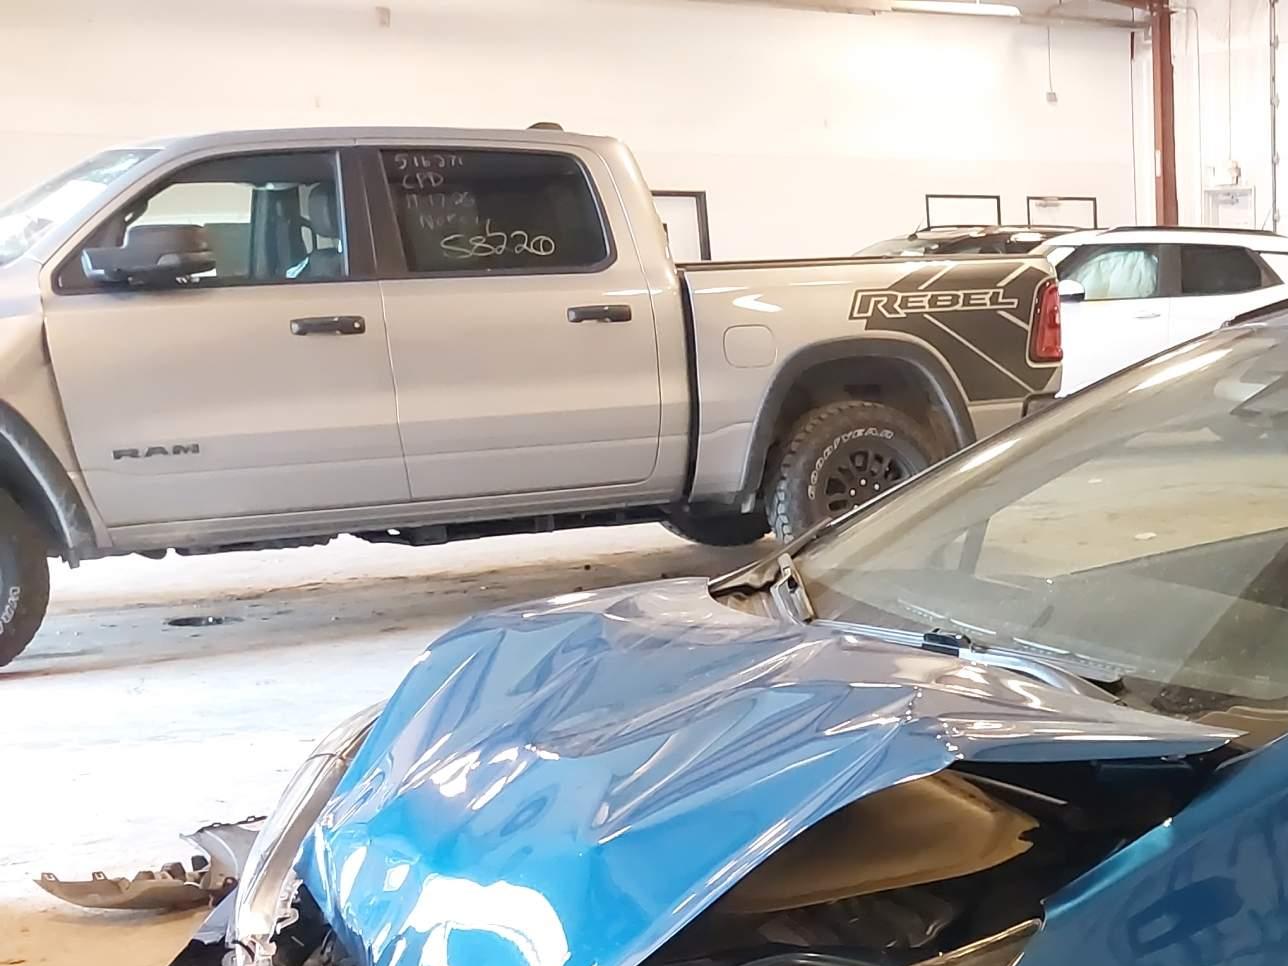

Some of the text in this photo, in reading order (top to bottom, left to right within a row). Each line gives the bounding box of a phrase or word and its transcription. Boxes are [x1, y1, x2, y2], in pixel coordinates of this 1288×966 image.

[851, 288, 1019, 318] REBEL
[112, 443, 200, 460] RAM
[807, 427, 894, 500] GOODYEAR
